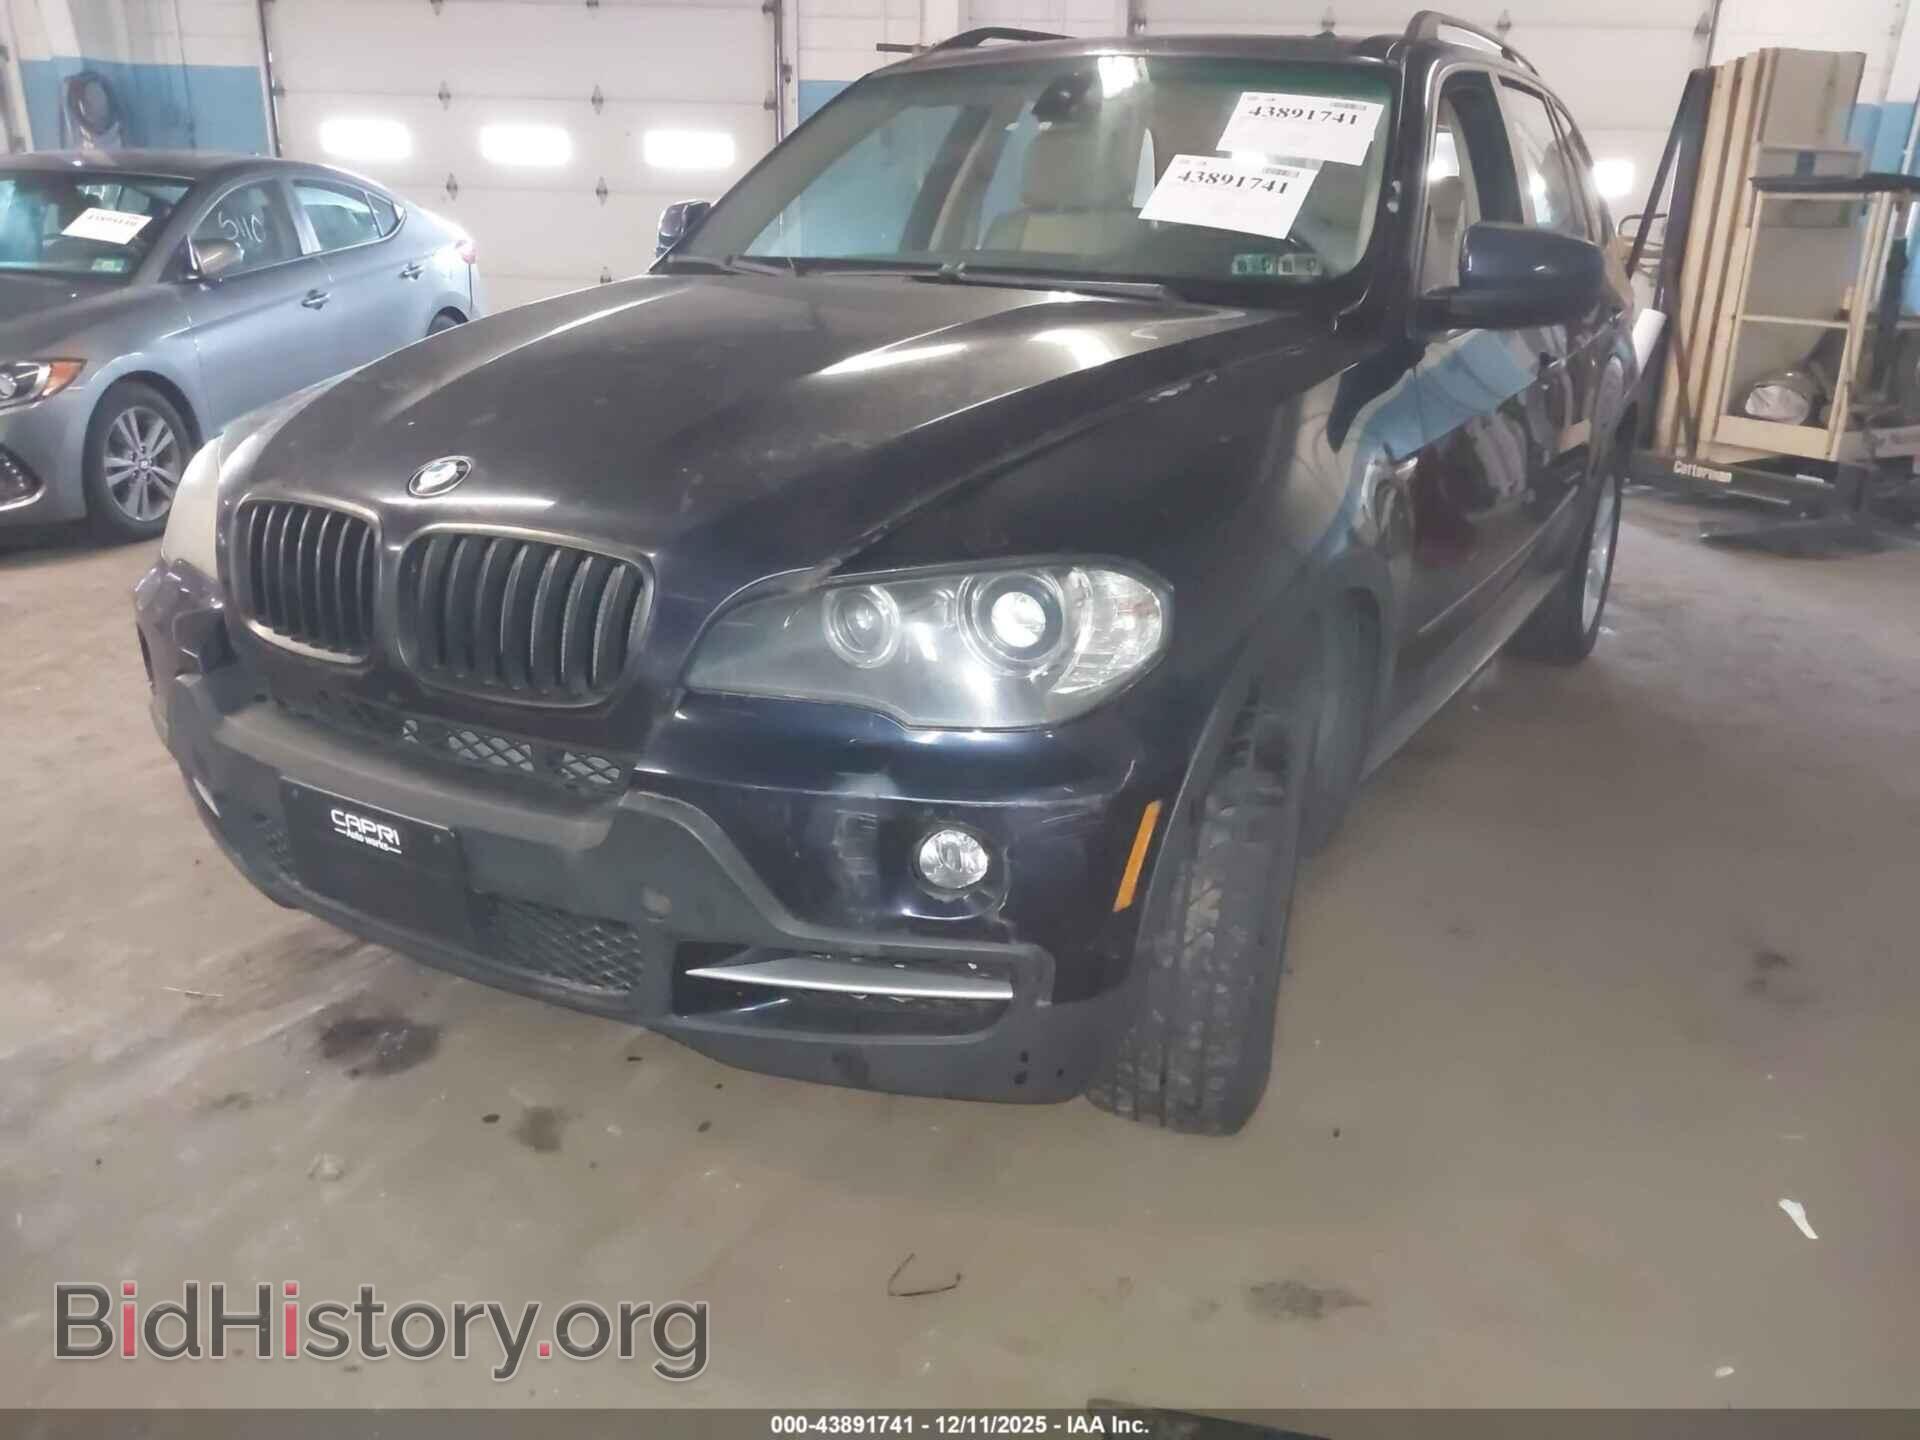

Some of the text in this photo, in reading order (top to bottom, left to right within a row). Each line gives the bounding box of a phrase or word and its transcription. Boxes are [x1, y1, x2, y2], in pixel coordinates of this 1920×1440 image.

[1248, 105, 1357, 125] 43891741
[1178, 170, 1288, 194] 43891741
[330, 808, 400, 846] CAPRI
